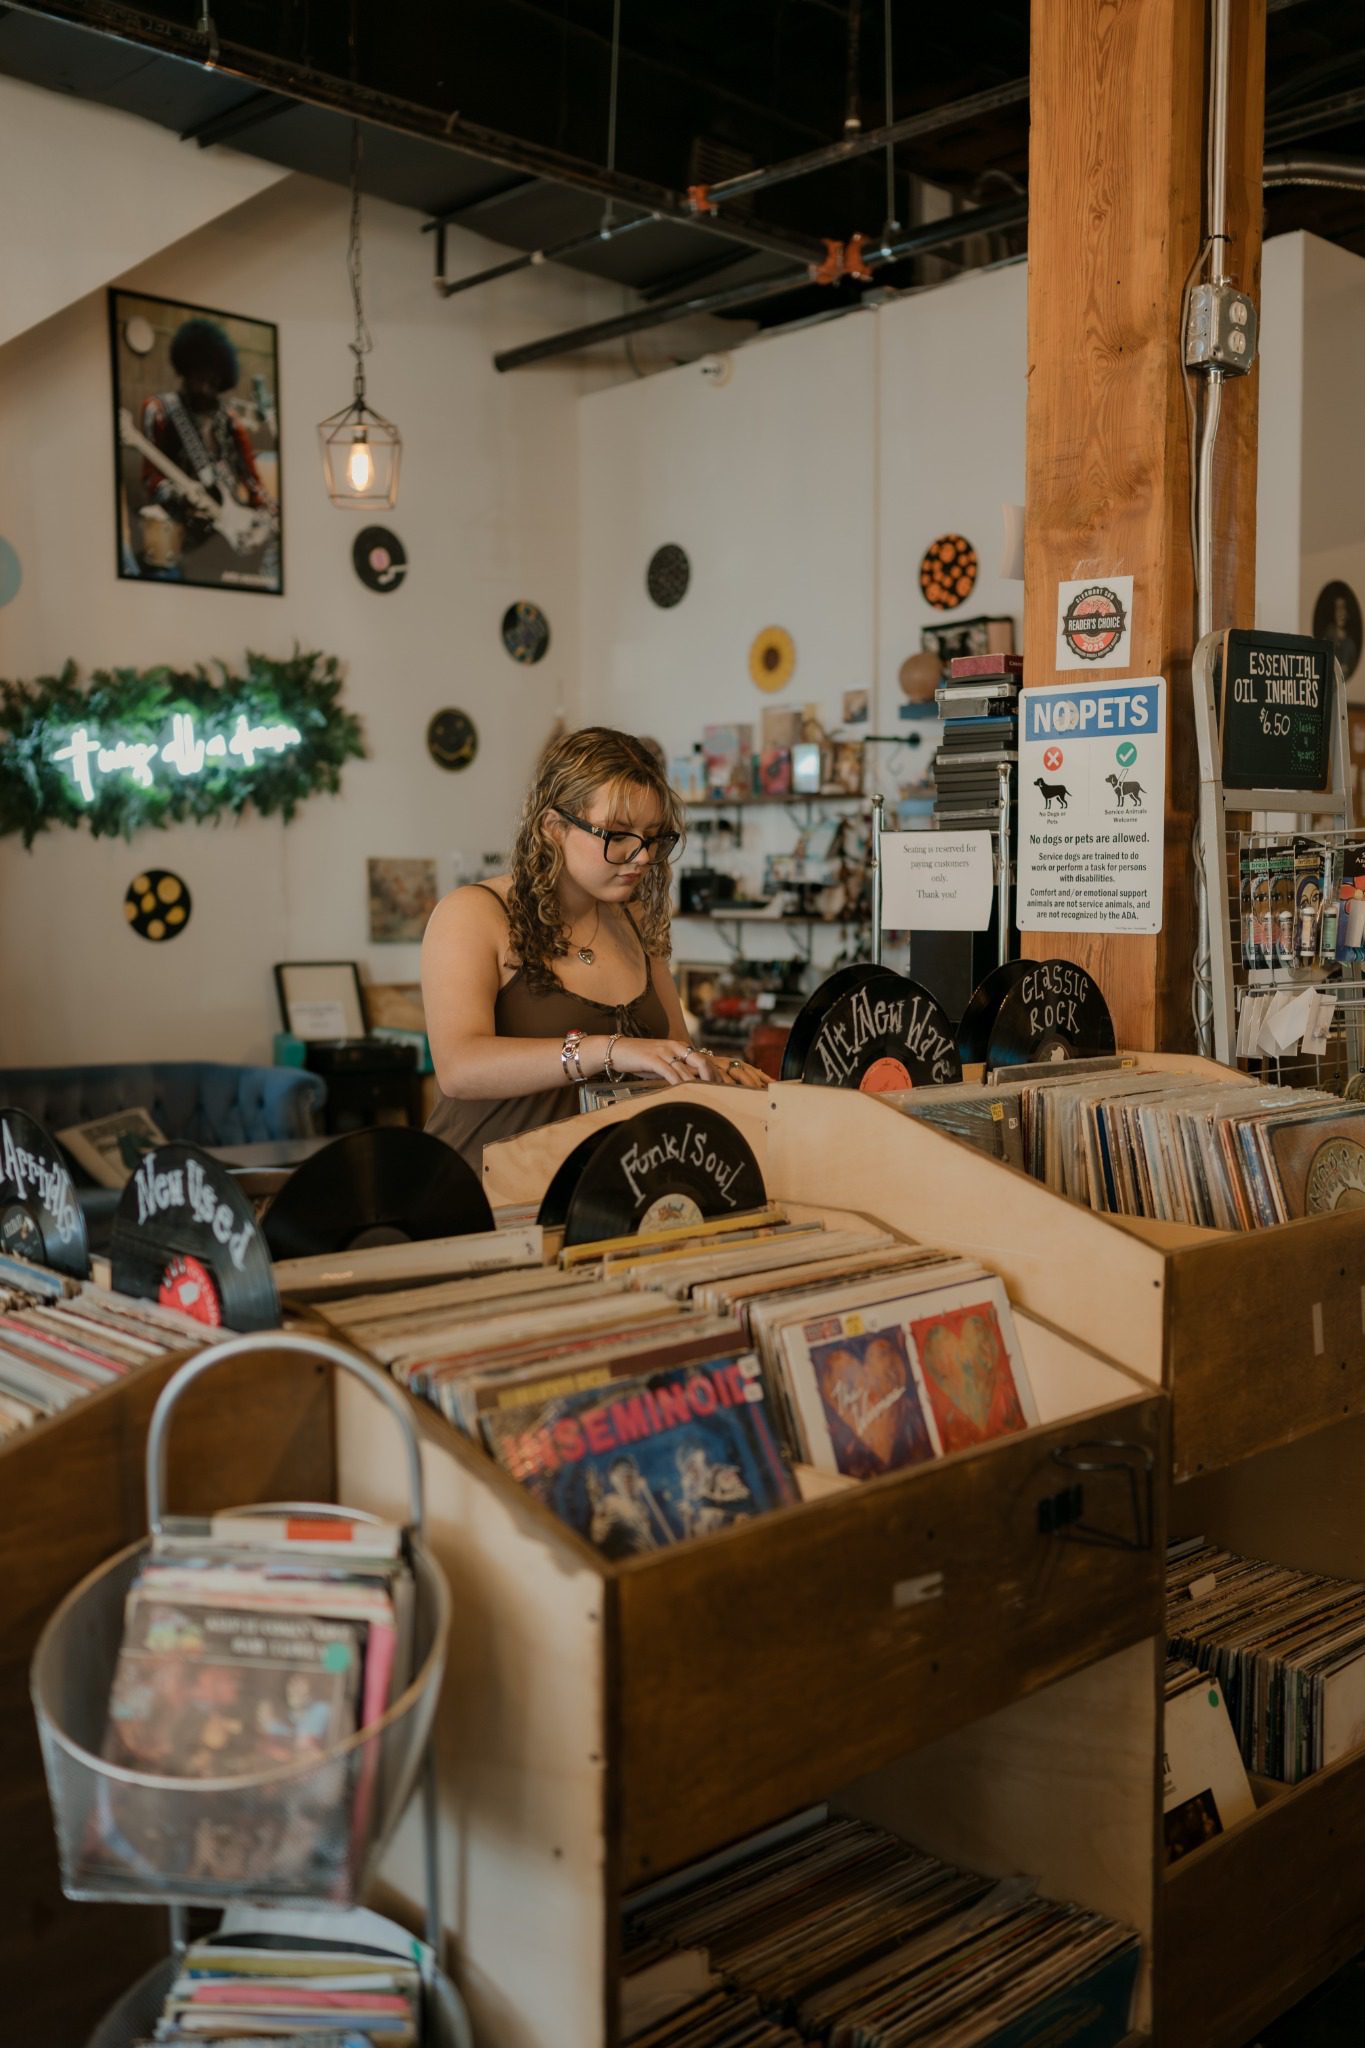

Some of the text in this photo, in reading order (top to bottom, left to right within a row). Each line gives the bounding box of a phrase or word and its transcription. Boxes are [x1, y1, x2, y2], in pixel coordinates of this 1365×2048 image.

[1068, 616, 1121, 631] READER'S CHOICE
[1249, 651, 1320, 680] ESSENTIAL
[1234, 678, 1319, 708] OIL INHALERS
[1079, 694, 1149, 731] PETS
[1259, 707, 1291, 736] $6.50
[1029, 832, 1150, 846] No dogs or pets are allowed.
[903, 843, 976, 855] Seating is reserved for
[1039, 852, 1063, 861] Service
[1064, 852, 1081, 861] dogs
[1095, 851, 1120, 860] trained
[1121, 851, 1129, 860] to
[1130, 851, 1139, 860] do
[910, 859, 969, 870] paying customers
[1031, 863, 1047, 871] work
[1056, 863, 1083, 872] perform
[1090, 863, 1105, 871] task
[1107, 863, 1117, 871] for
[1118, 864, 1147, 872] persons
[1060, 874, 1115, 882] with disabilities.
[916, 889, 957, 900] Thank you!
[1030, 888, 1148, 899] Comfort and/or emotional support
[1027, 899, 1053, 907] animals
[1066, 899, 1078, 908] not
[1079, 900, 1103, 908] service
[1104, 900, 1135, 909] animals,
[1137, 900, 1151, 908] and
[1049, 910, 1060, 918] not
[1061, 911, 1097, 920] recognized
[1099, 911, 1107, 920] by
[1108, 911, 1120, 919] the
[1121, 911, 1139, 920] ADA.
[1030, 999, 1080, 1036] ROCK
[905, 996, 955, 1083] Wave
[134, 1152, 256, 1273] New Used
